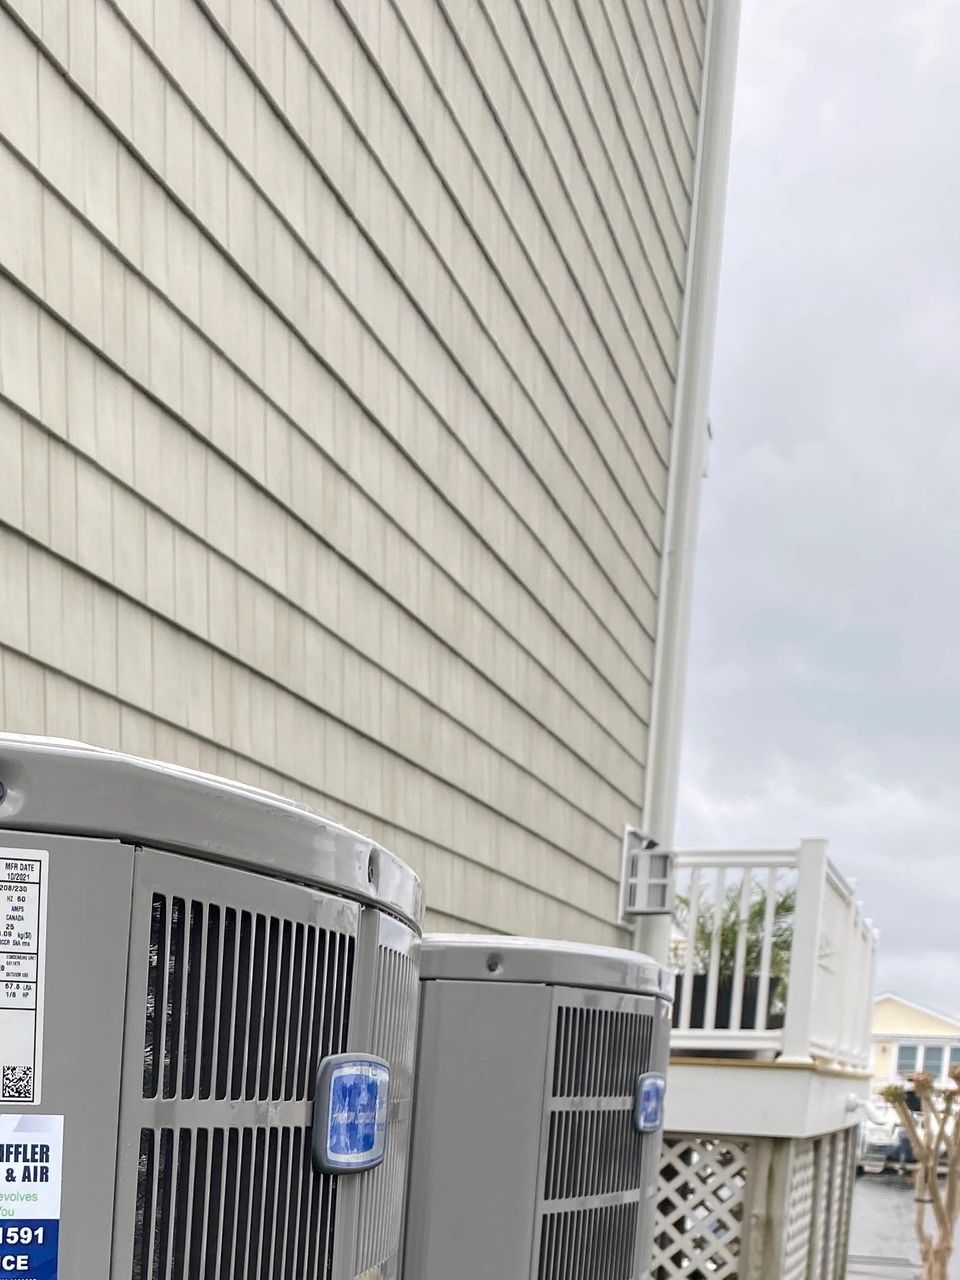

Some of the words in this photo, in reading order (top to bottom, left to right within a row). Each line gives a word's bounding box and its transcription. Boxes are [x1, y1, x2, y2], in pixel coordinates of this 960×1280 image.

[5, 862, 18, 870] MFR
[20, 863, 34, 872] DATE
[7, 873, 30, 881] 10/2021
[0, 884, 28, 893] 208/230
[5, 1167, 16, 1182] &
[21, 1166, 49, 1183] AIR
